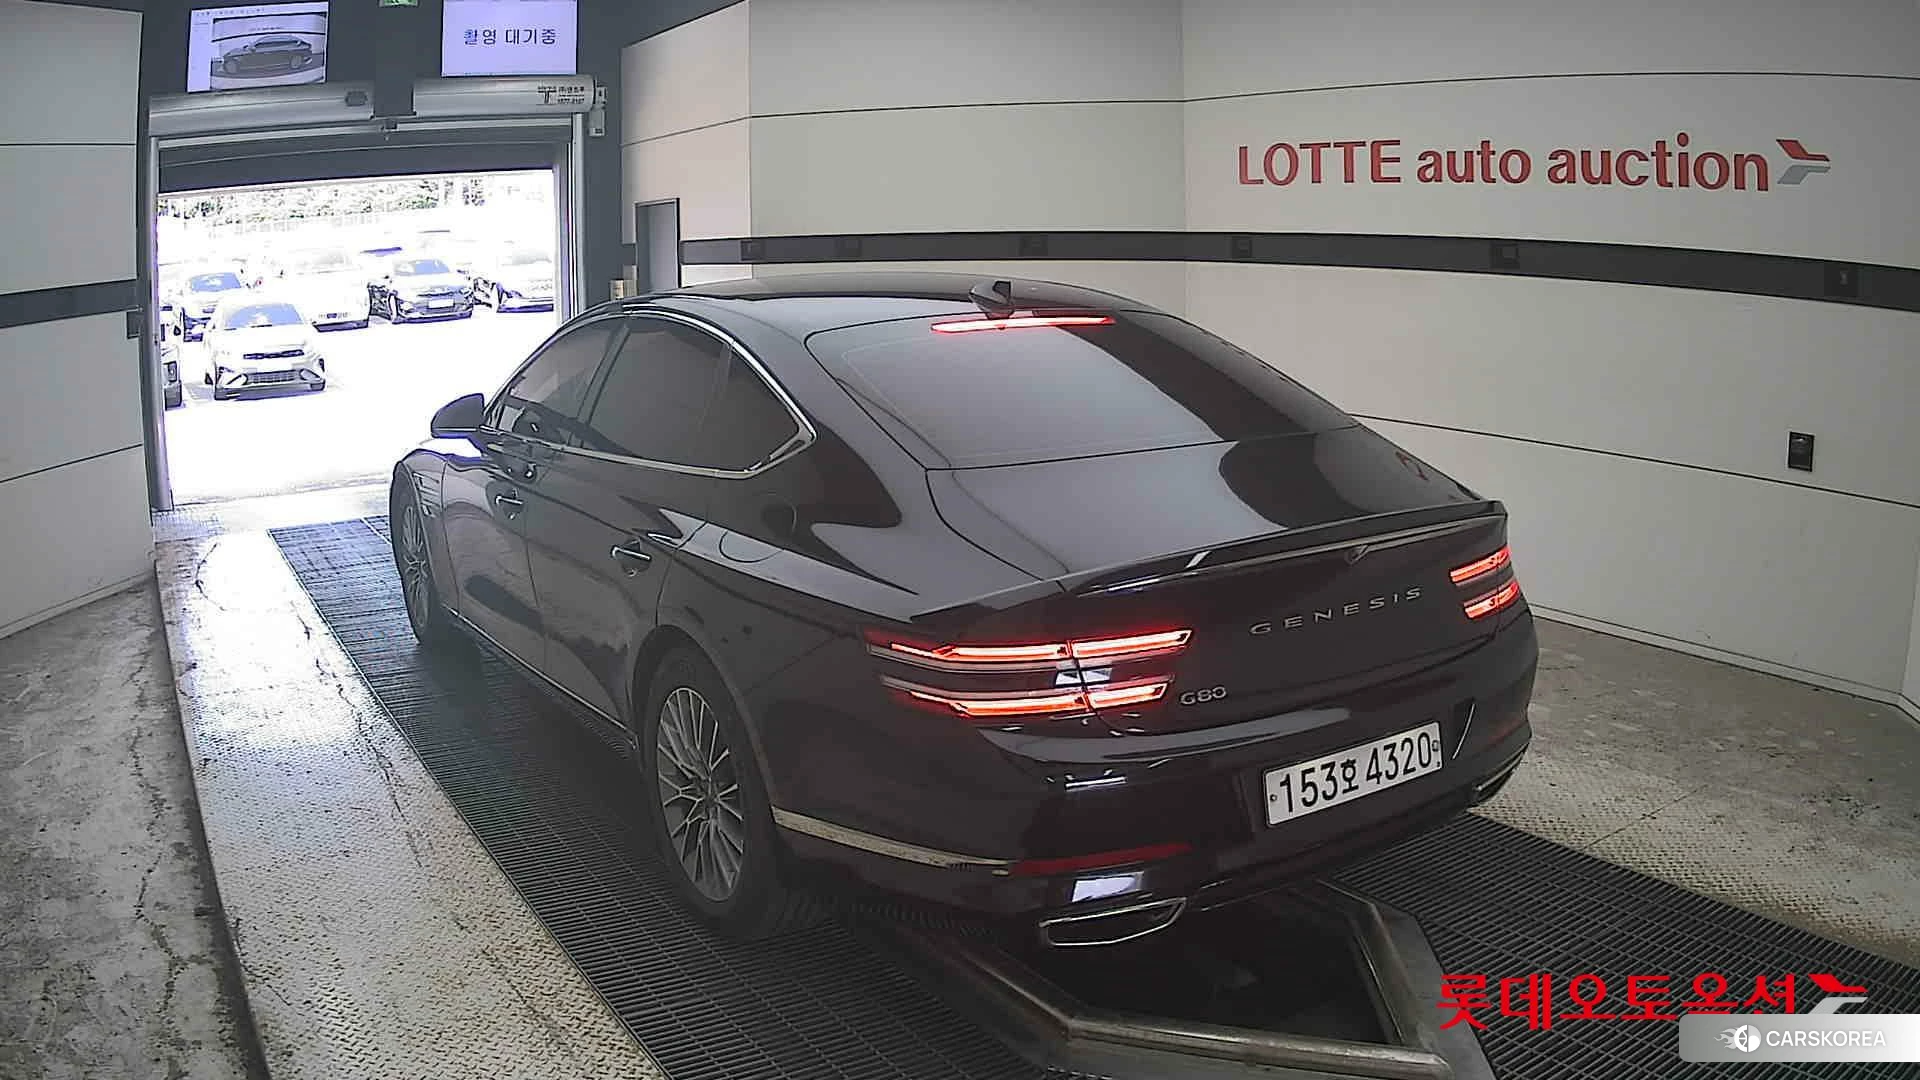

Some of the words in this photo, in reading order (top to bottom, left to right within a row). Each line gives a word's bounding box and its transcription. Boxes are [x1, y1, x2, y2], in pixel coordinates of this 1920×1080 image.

[464, 28, 497, 46] 촬영
[505, 28, 557, 46] 대기중
[1238, 139, 1401, 186] LOTTE
[1417, 139, 1532, 184] auto
[1547, 132, 1769, 192] auction
[1249, 587, 1422, 634] GENESIS
[1180, 686, 1228, 706] G80
[1279, 758, 1359, 814] 153호
[1365, 732, 1432, 785] 4320
